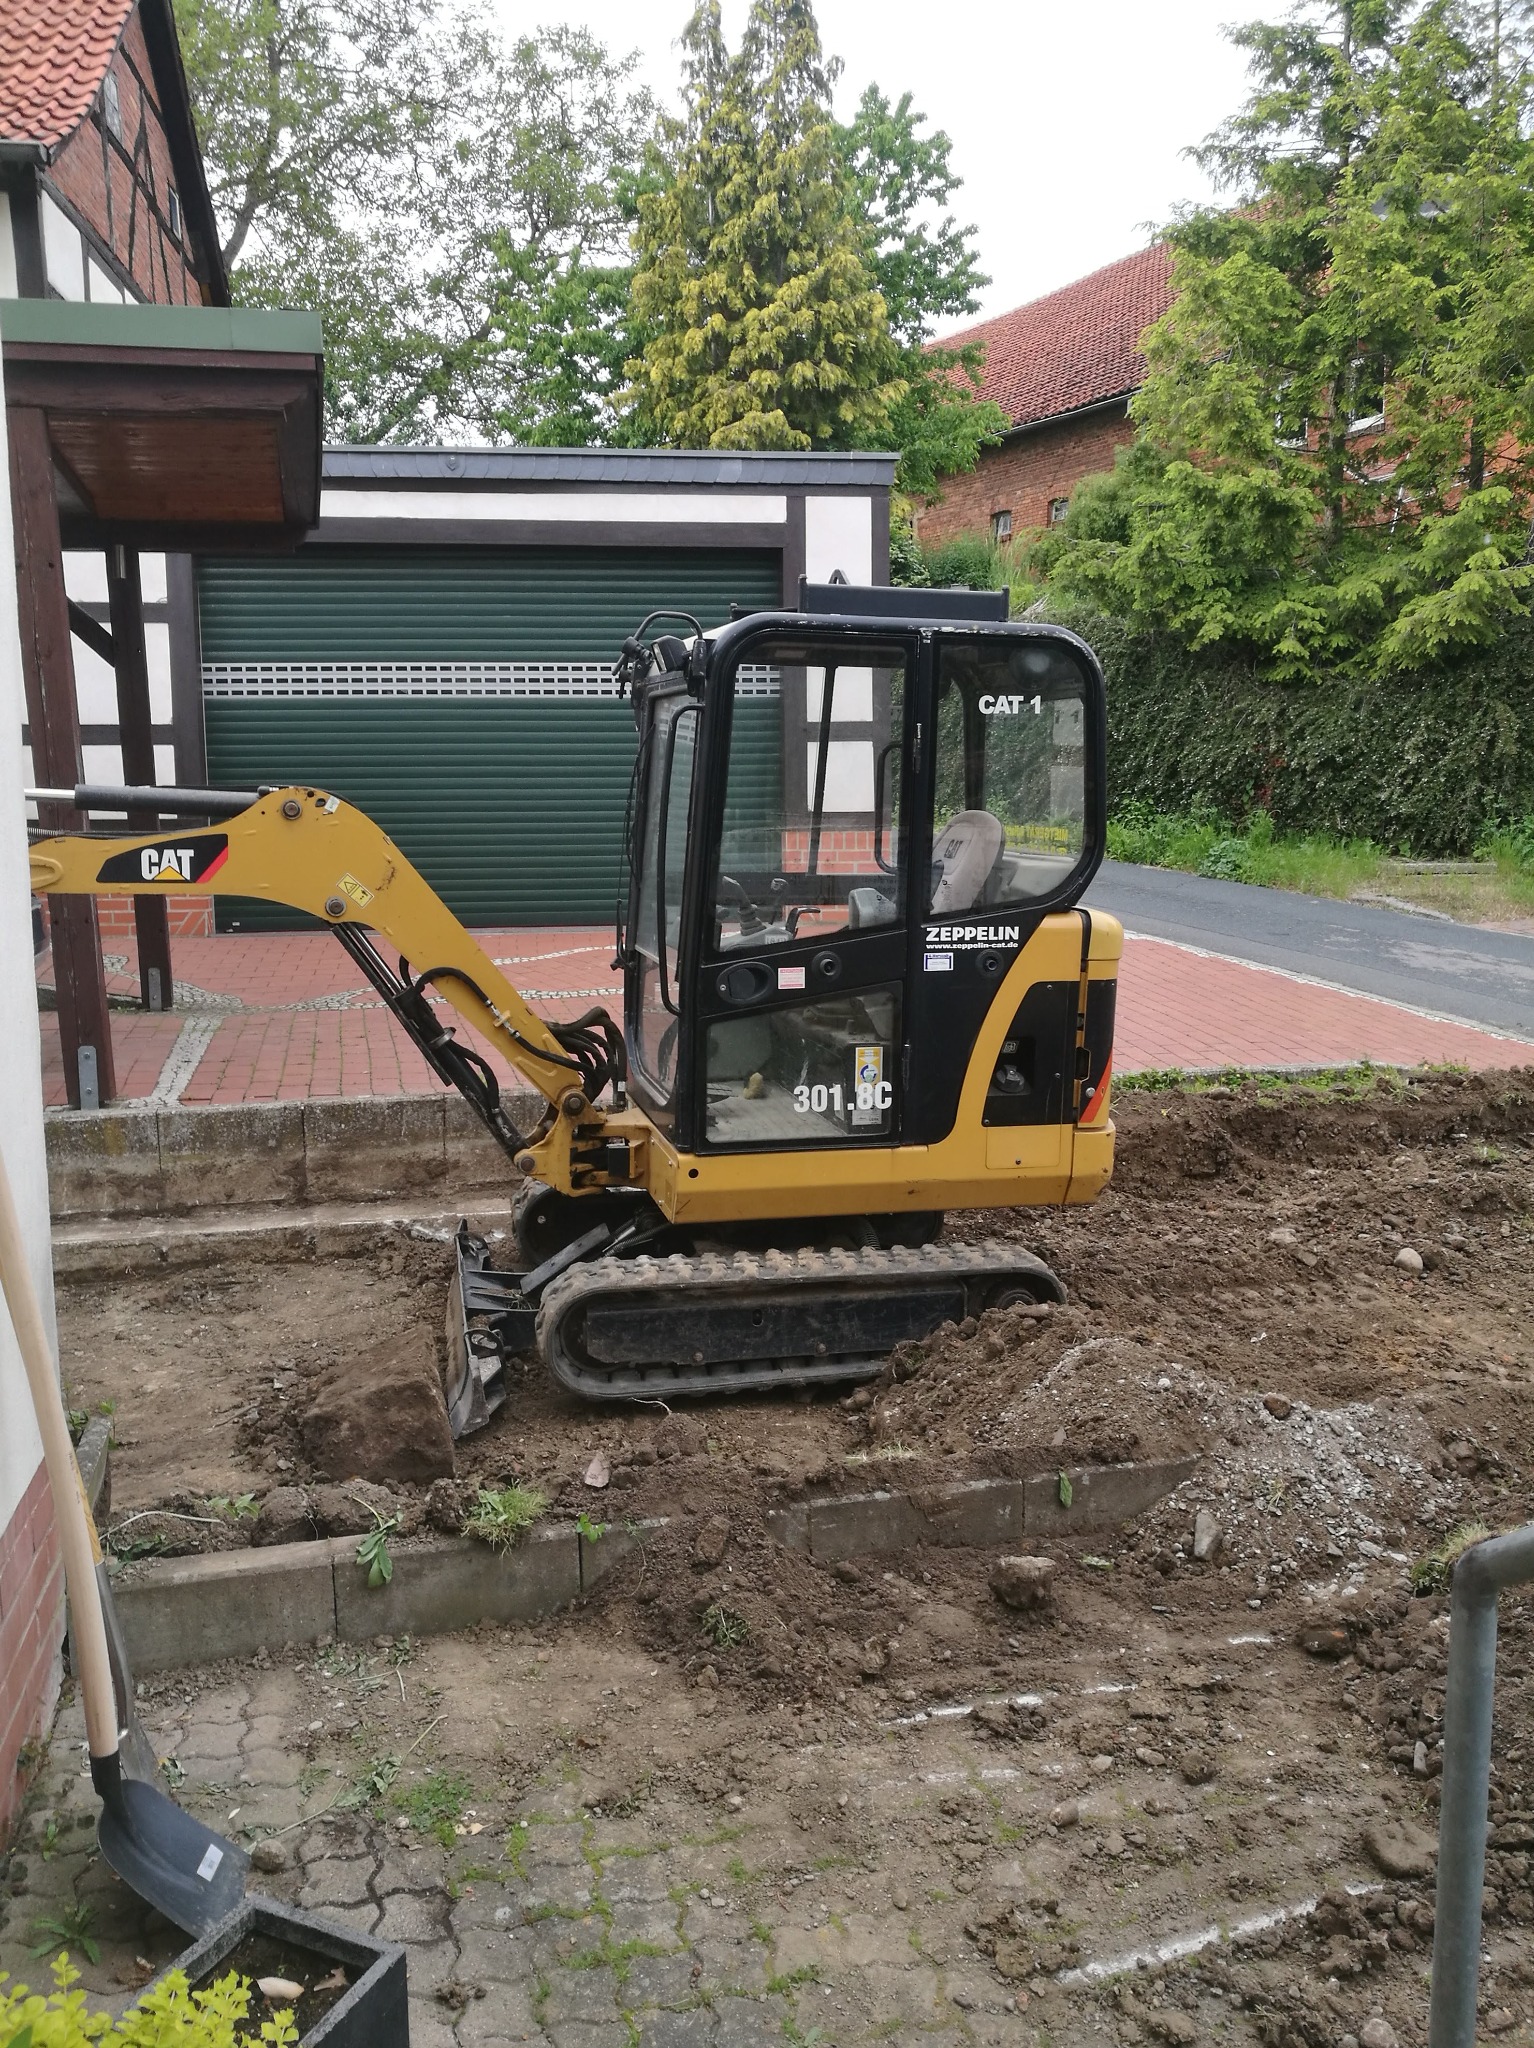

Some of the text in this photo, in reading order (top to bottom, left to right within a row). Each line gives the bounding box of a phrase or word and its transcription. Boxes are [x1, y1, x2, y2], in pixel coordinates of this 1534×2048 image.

[978, 694, 1042, 715] CAT 1
[944, 838, 963, 859] CAT
[140, 848, 195, 881] CAT
[925, 926, 1020, 942] ZEPPELIN
[925, 942, 1019, 950] www.zeppelin-cat.de
[793, 1080, 893, 1113] 301.8C
